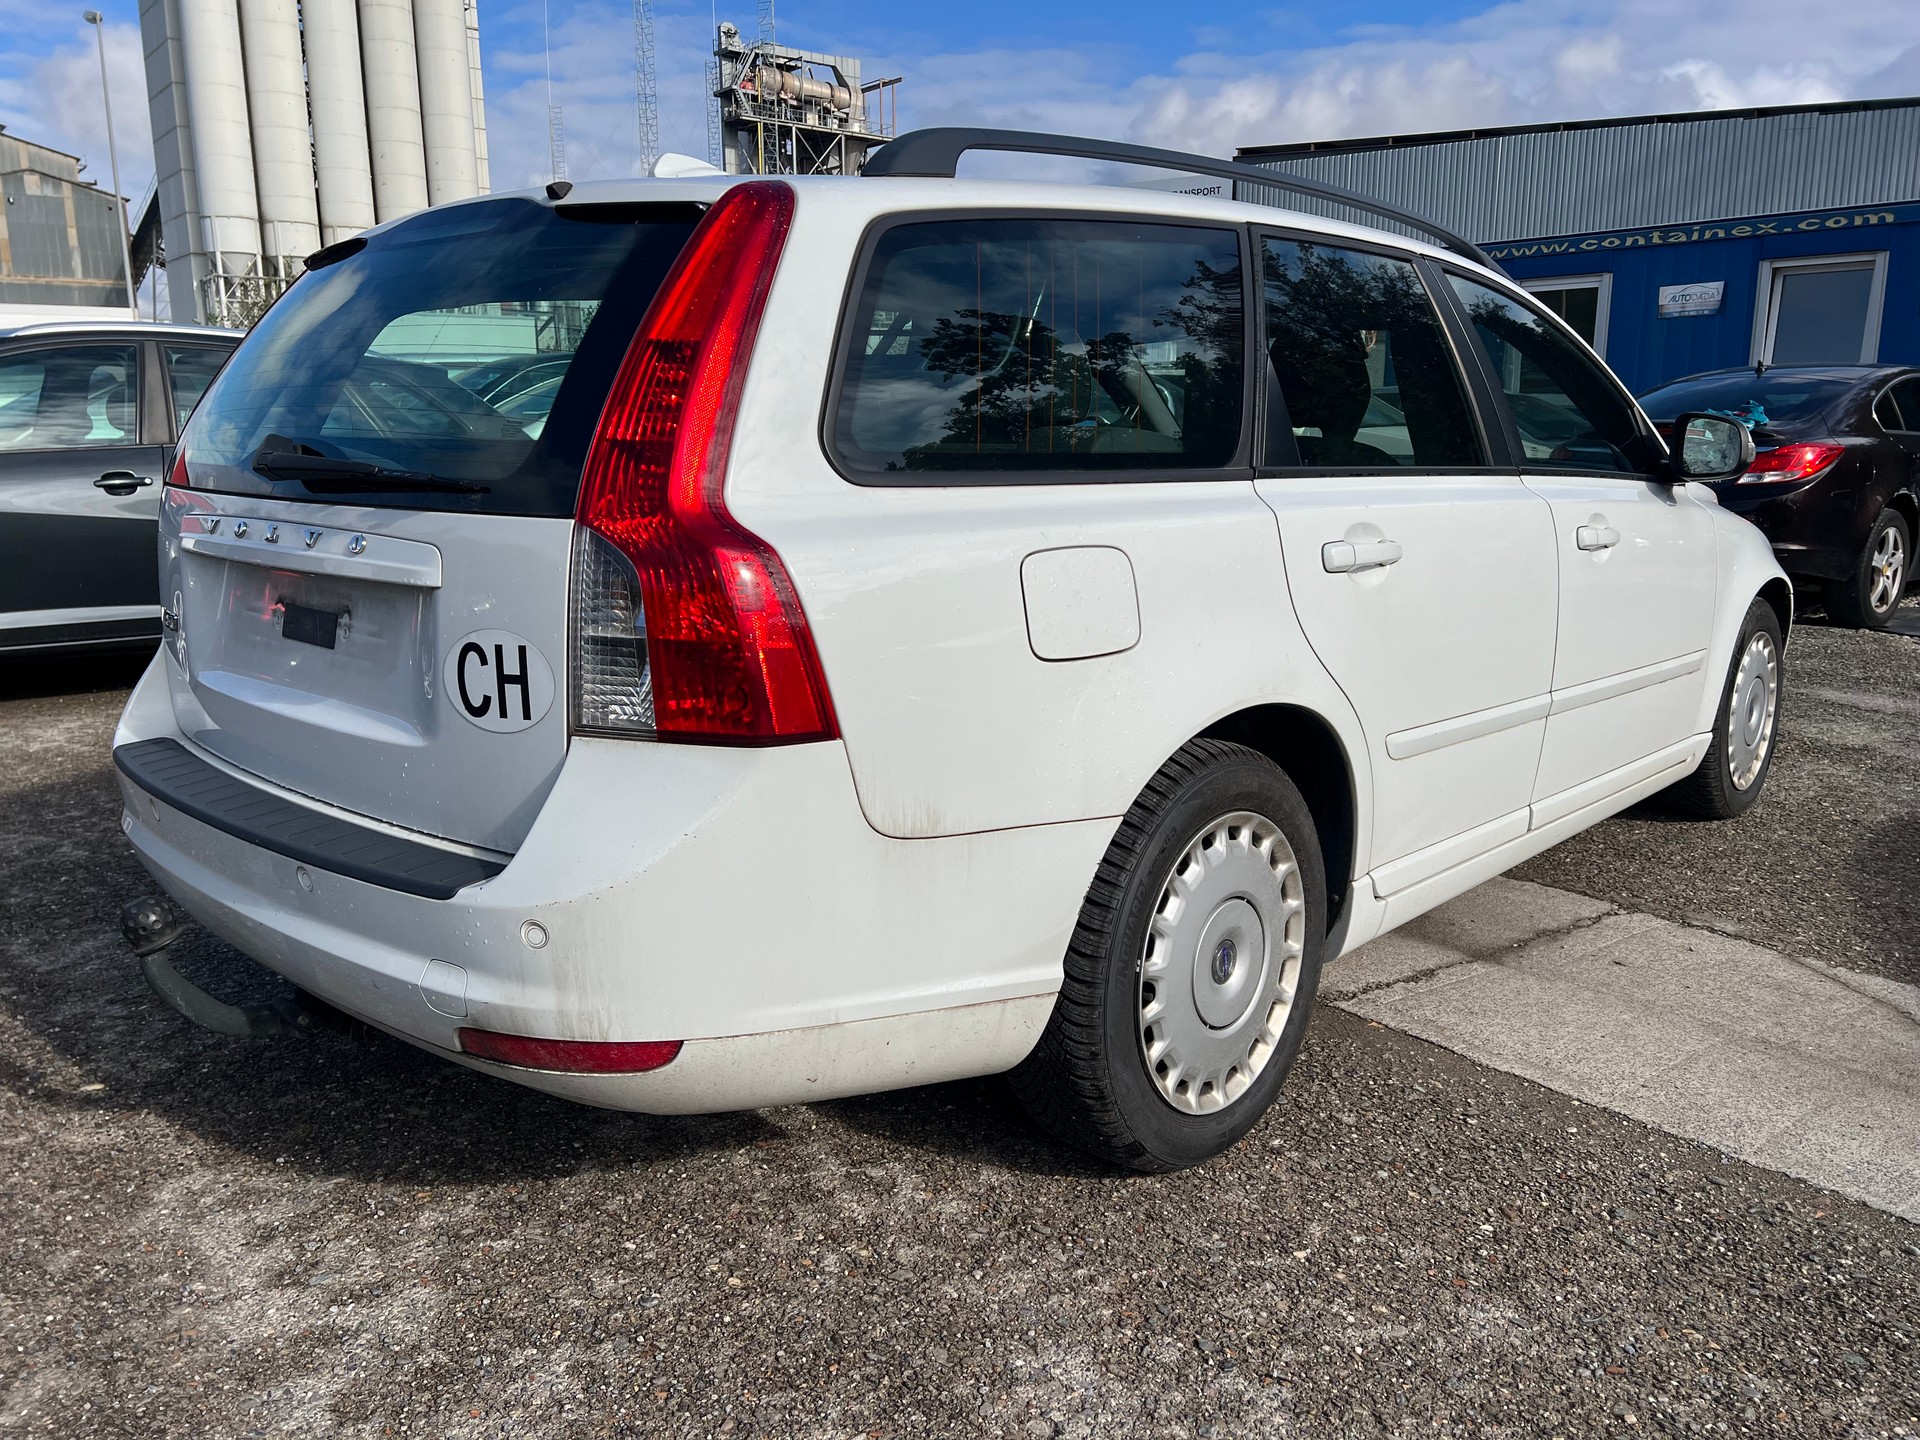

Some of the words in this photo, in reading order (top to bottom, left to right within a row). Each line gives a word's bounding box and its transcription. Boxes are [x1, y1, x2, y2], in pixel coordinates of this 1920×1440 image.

[1490, 210, 1896, 258] www.containex.com
[207, 516, 367, 555] VOLVO
[457, 641, 532, 721] CH
